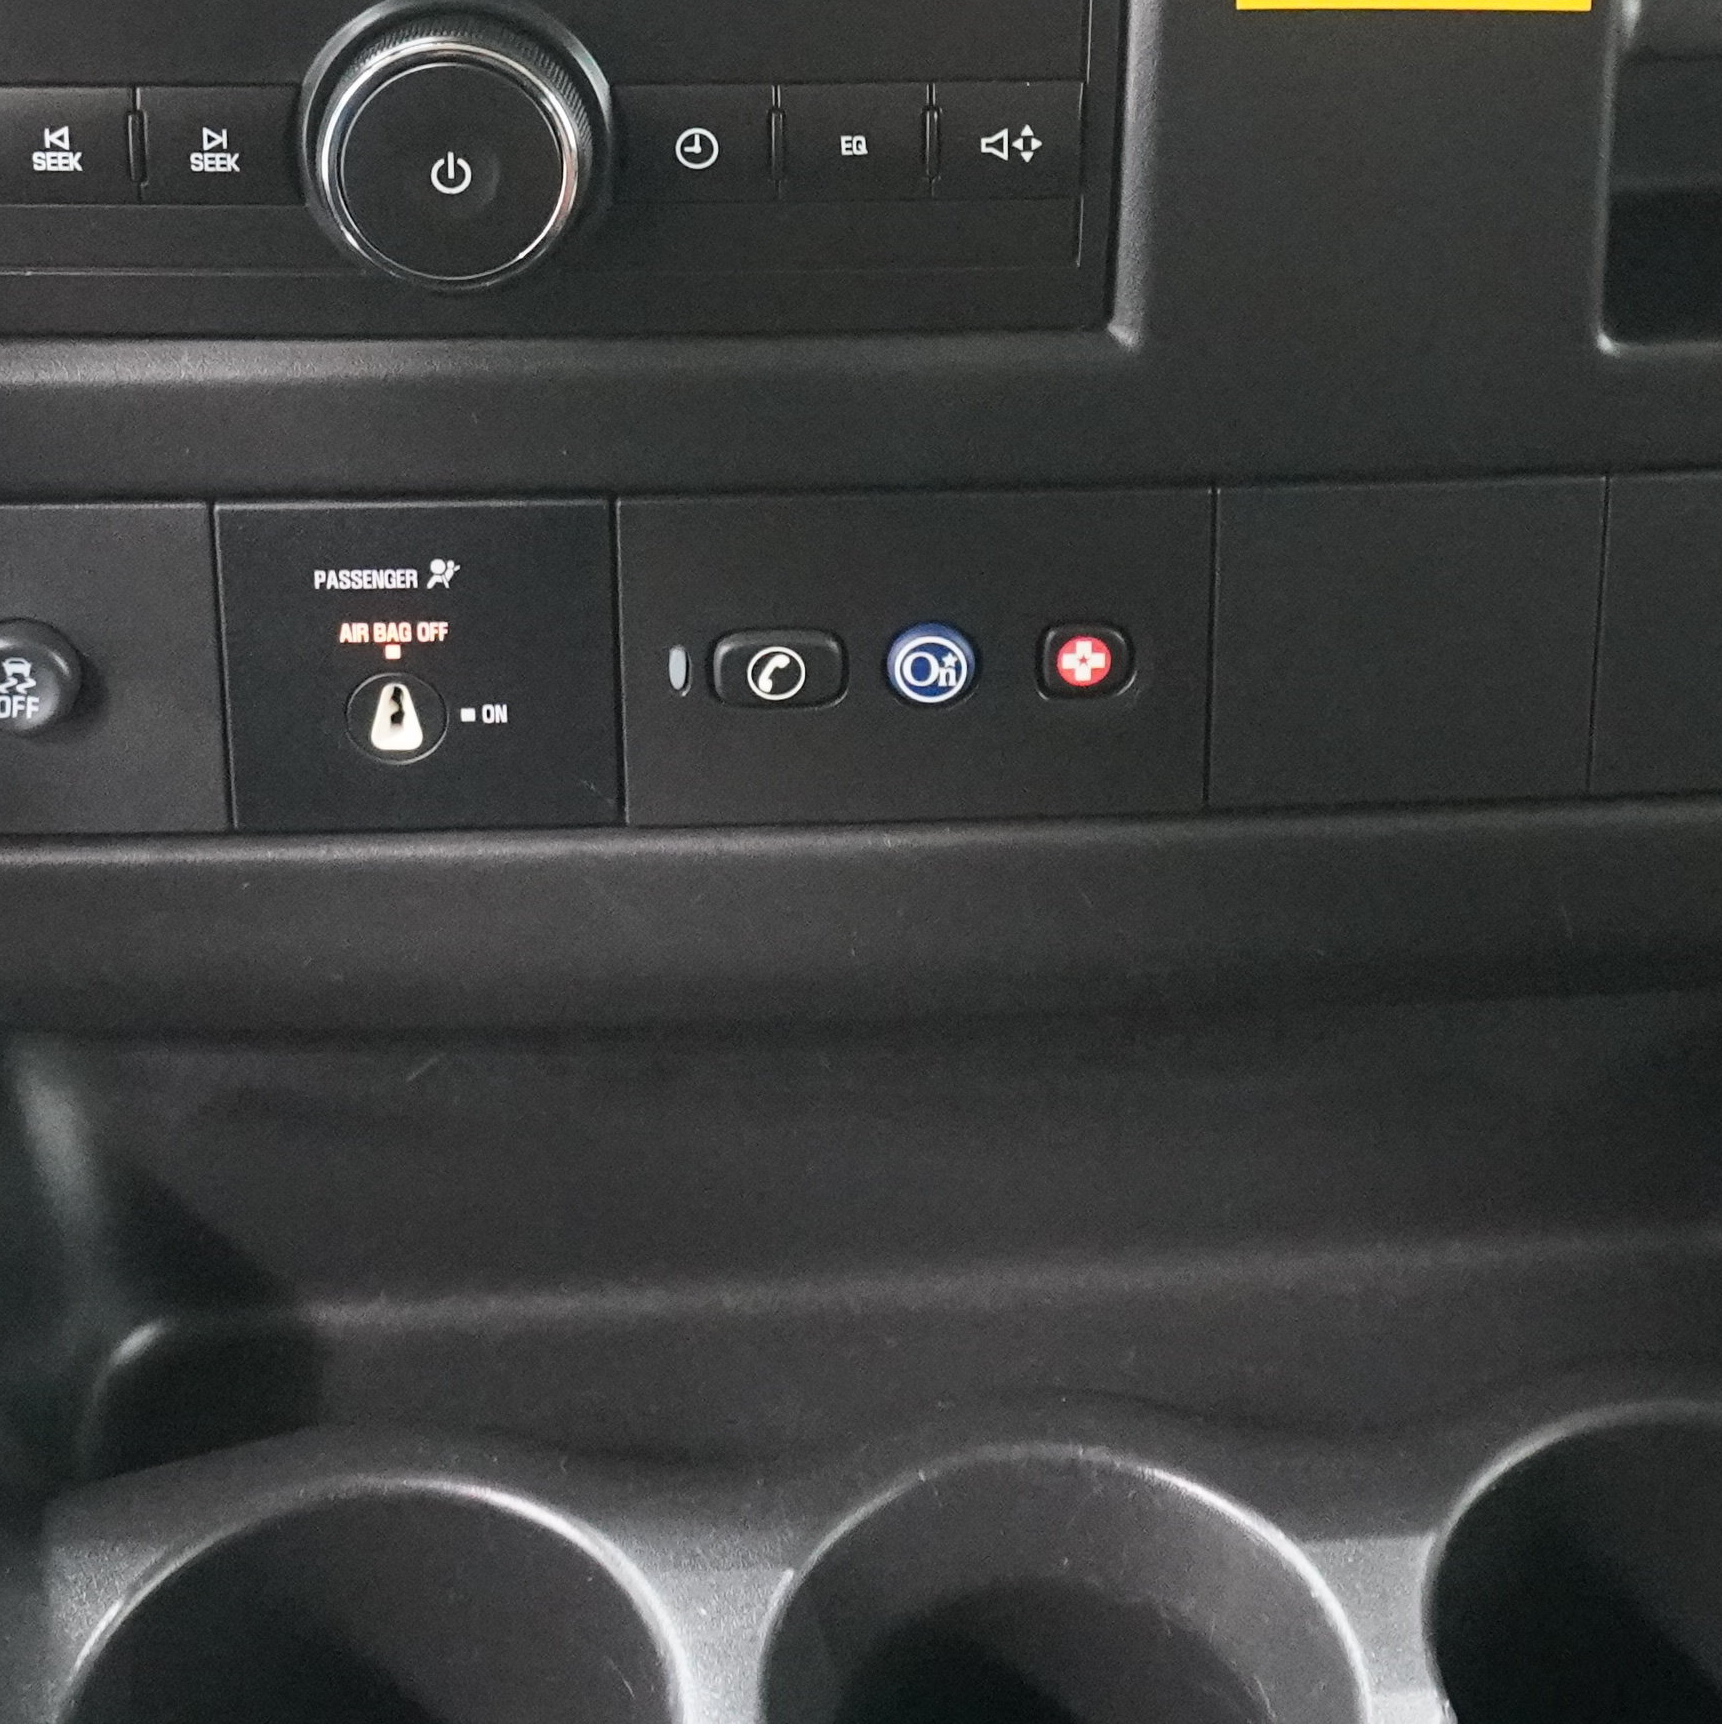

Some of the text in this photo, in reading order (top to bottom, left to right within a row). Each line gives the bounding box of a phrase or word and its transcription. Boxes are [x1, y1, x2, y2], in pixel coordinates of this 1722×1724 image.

[840, 135, 868, 156] EQ
[31, 151, 83, 172] SEEK
[189, 152, 240, 173] SEEK
[313, 568, 419, 590] PASSENGER
[339, 621, 449, 644] AIR BAG OFF
[481, 703, 508, 724] ON
